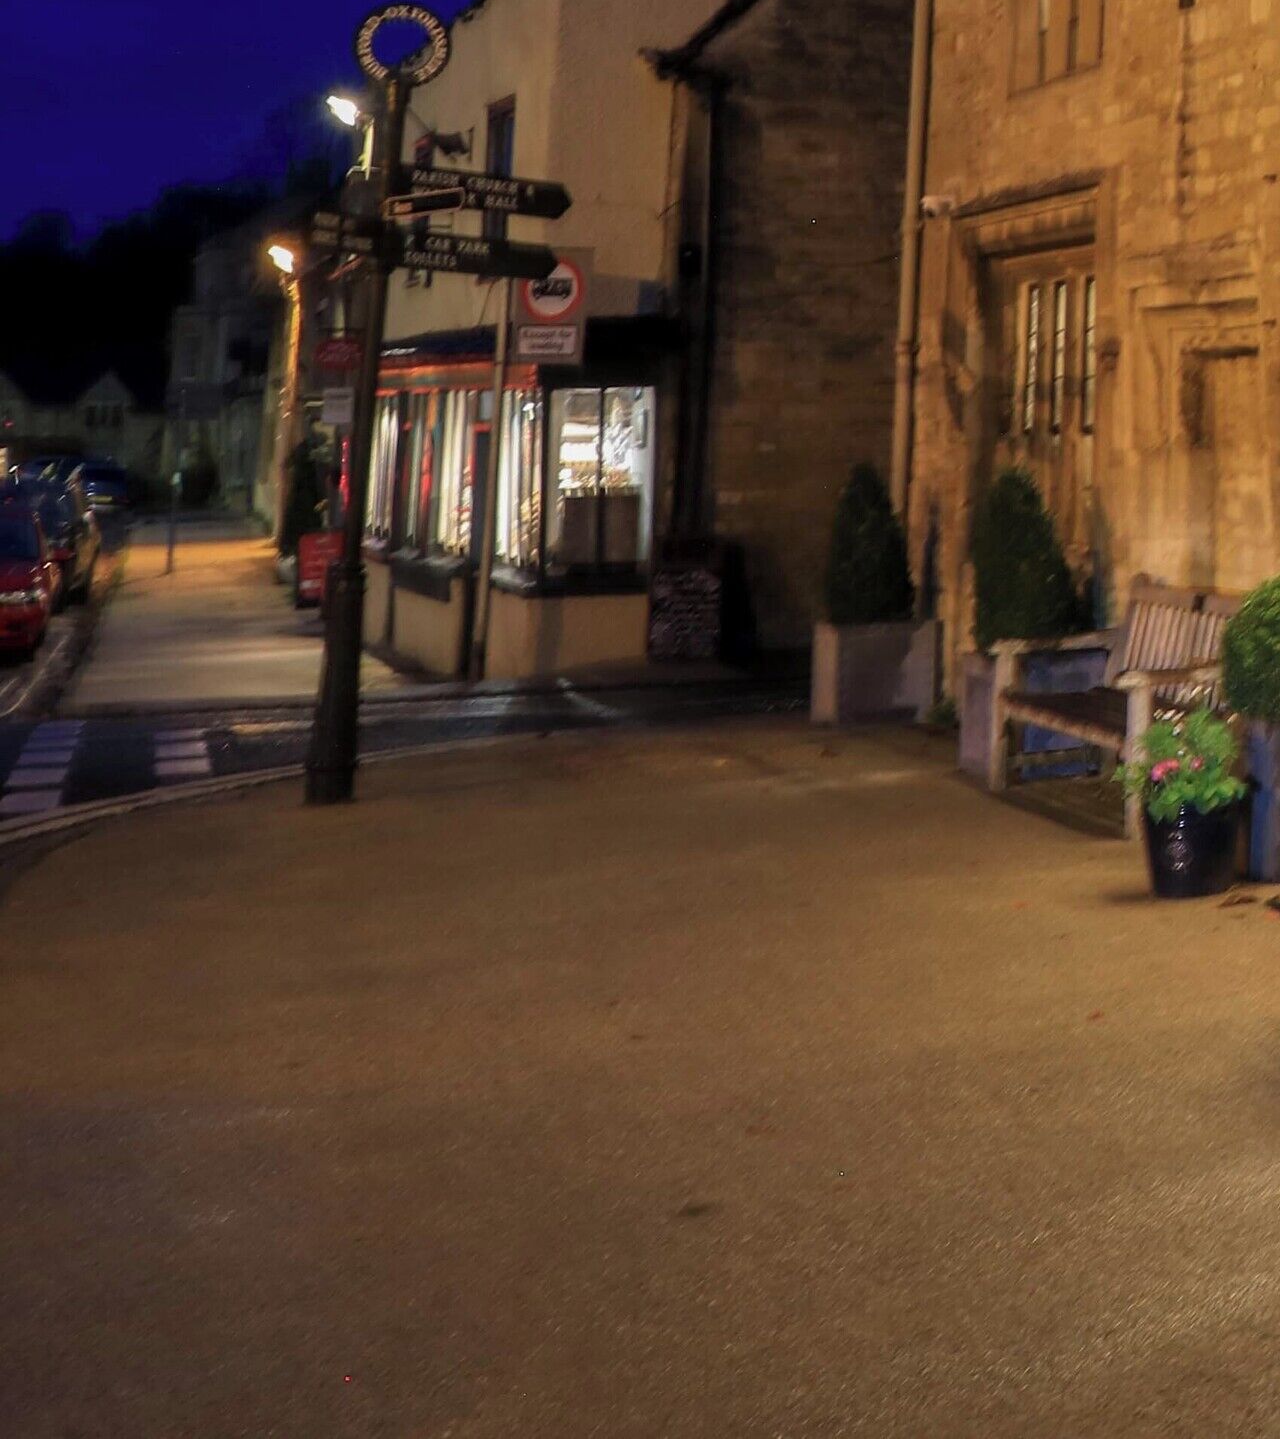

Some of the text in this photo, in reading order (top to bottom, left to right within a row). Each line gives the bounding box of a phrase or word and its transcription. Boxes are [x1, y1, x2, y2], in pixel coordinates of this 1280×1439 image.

[411, 169, 461, 187] PARISH
[467, 175, 520, 195] CHURCH
[483, 194, 519, 210] HALL
[425, 236, 452, 252] CAR
[456, 239, 491, 256] PARK
[404, 250, 457, 267] TOILETS
